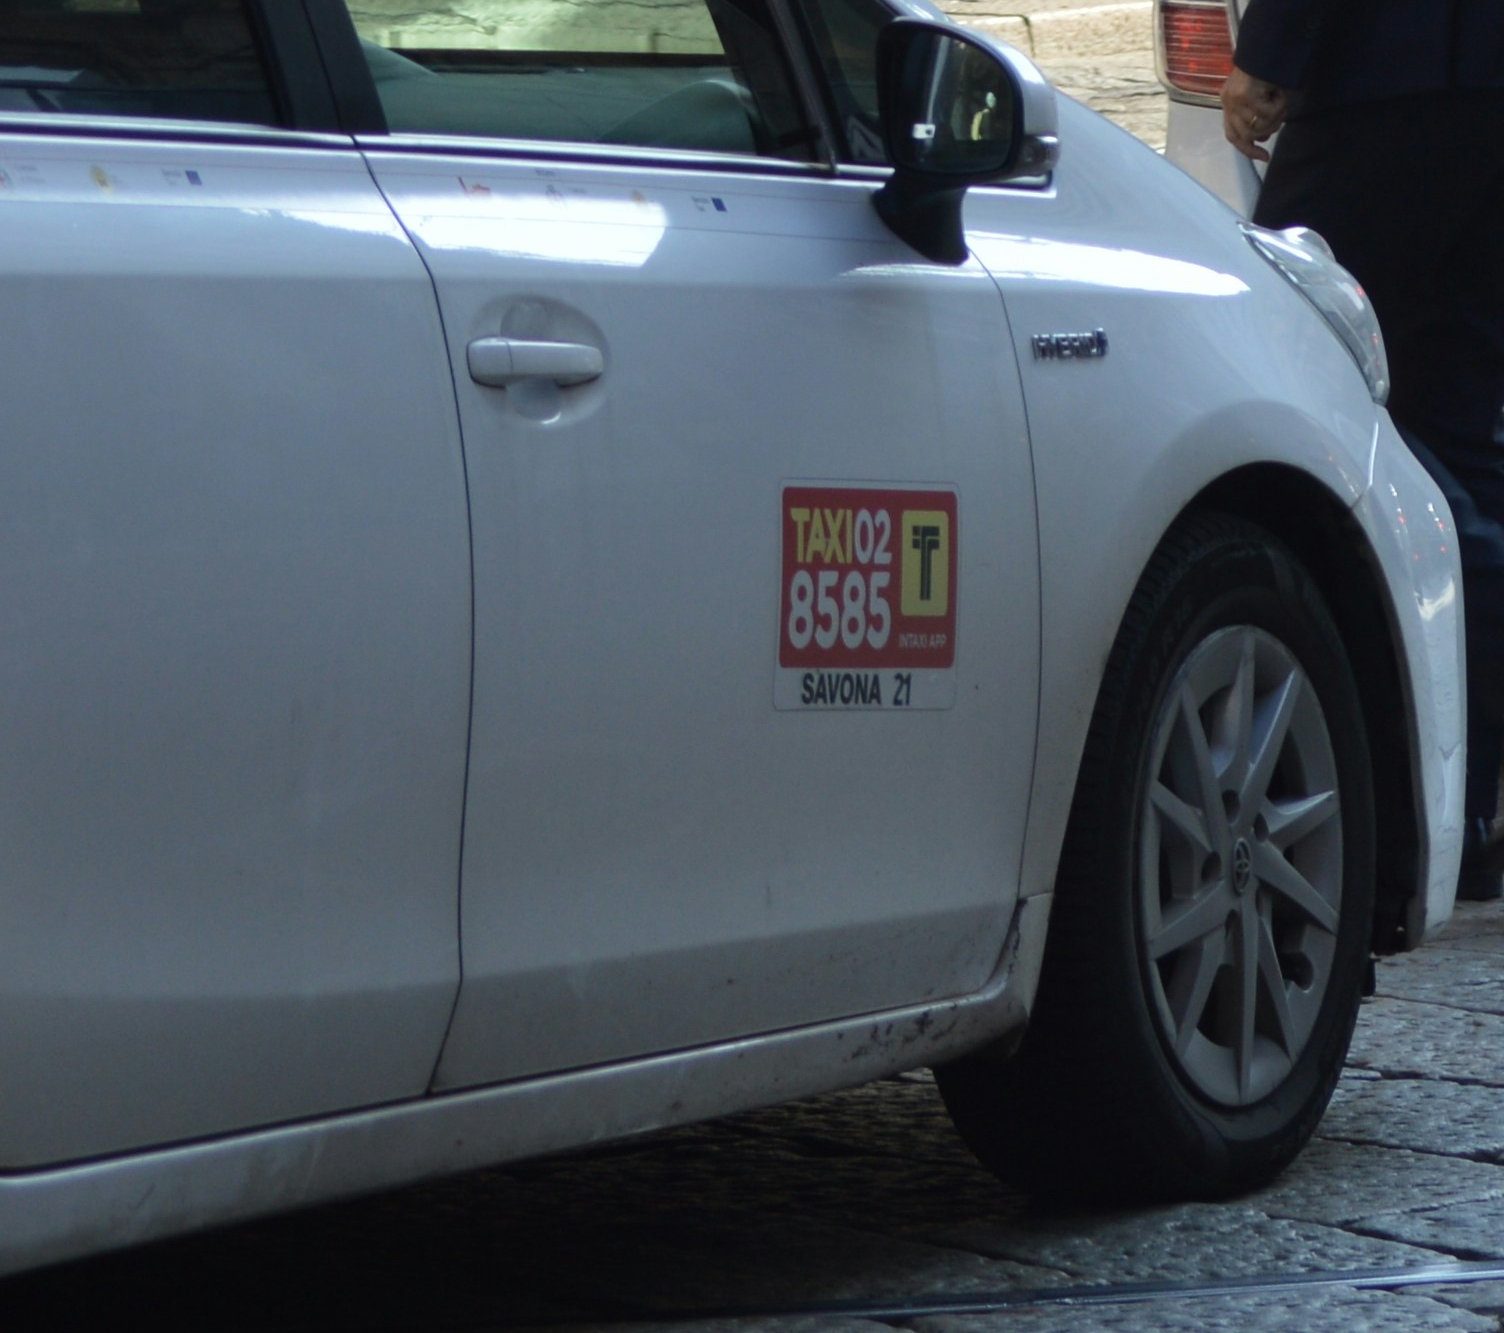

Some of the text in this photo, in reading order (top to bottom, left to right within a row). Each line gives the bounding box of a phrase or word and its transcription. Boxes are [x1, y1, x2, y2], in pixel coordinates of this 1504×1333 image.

[788, 569, 892, 650] 8585
[801, 672, 912, 706] SAVONA 21
